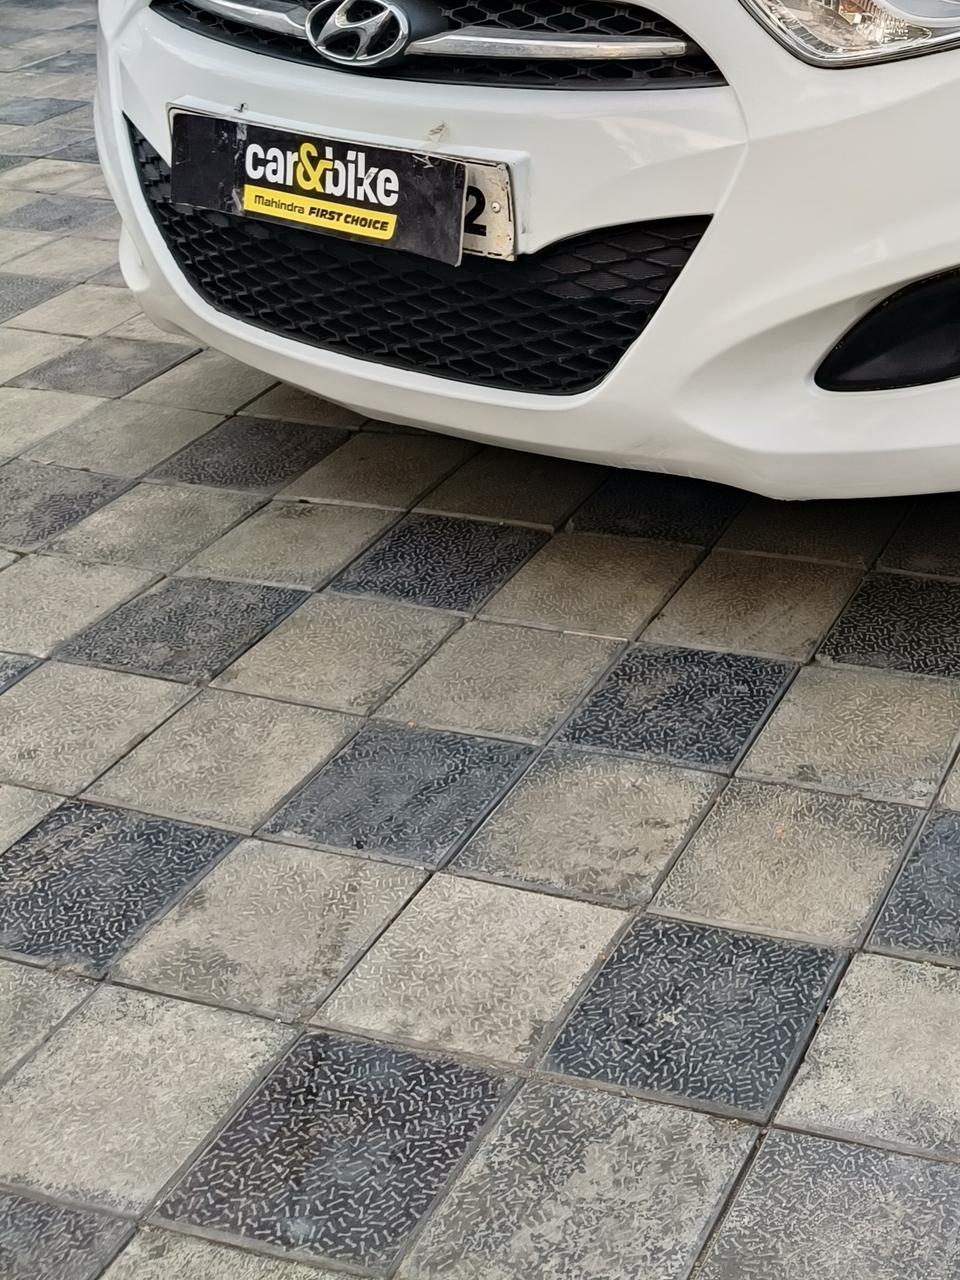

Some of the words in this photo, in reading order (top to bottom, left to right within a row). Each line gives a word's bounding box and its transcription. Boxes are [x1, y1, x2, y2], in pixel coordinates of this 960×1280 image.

[245, 143, 400, 207] car&bike
[254, 194, 305, 215] Mahindra
[308, 206, 344, 222] FIRST
[345, 214, 389, 232] CHOICE
[463, 185, 487, 237] 2
